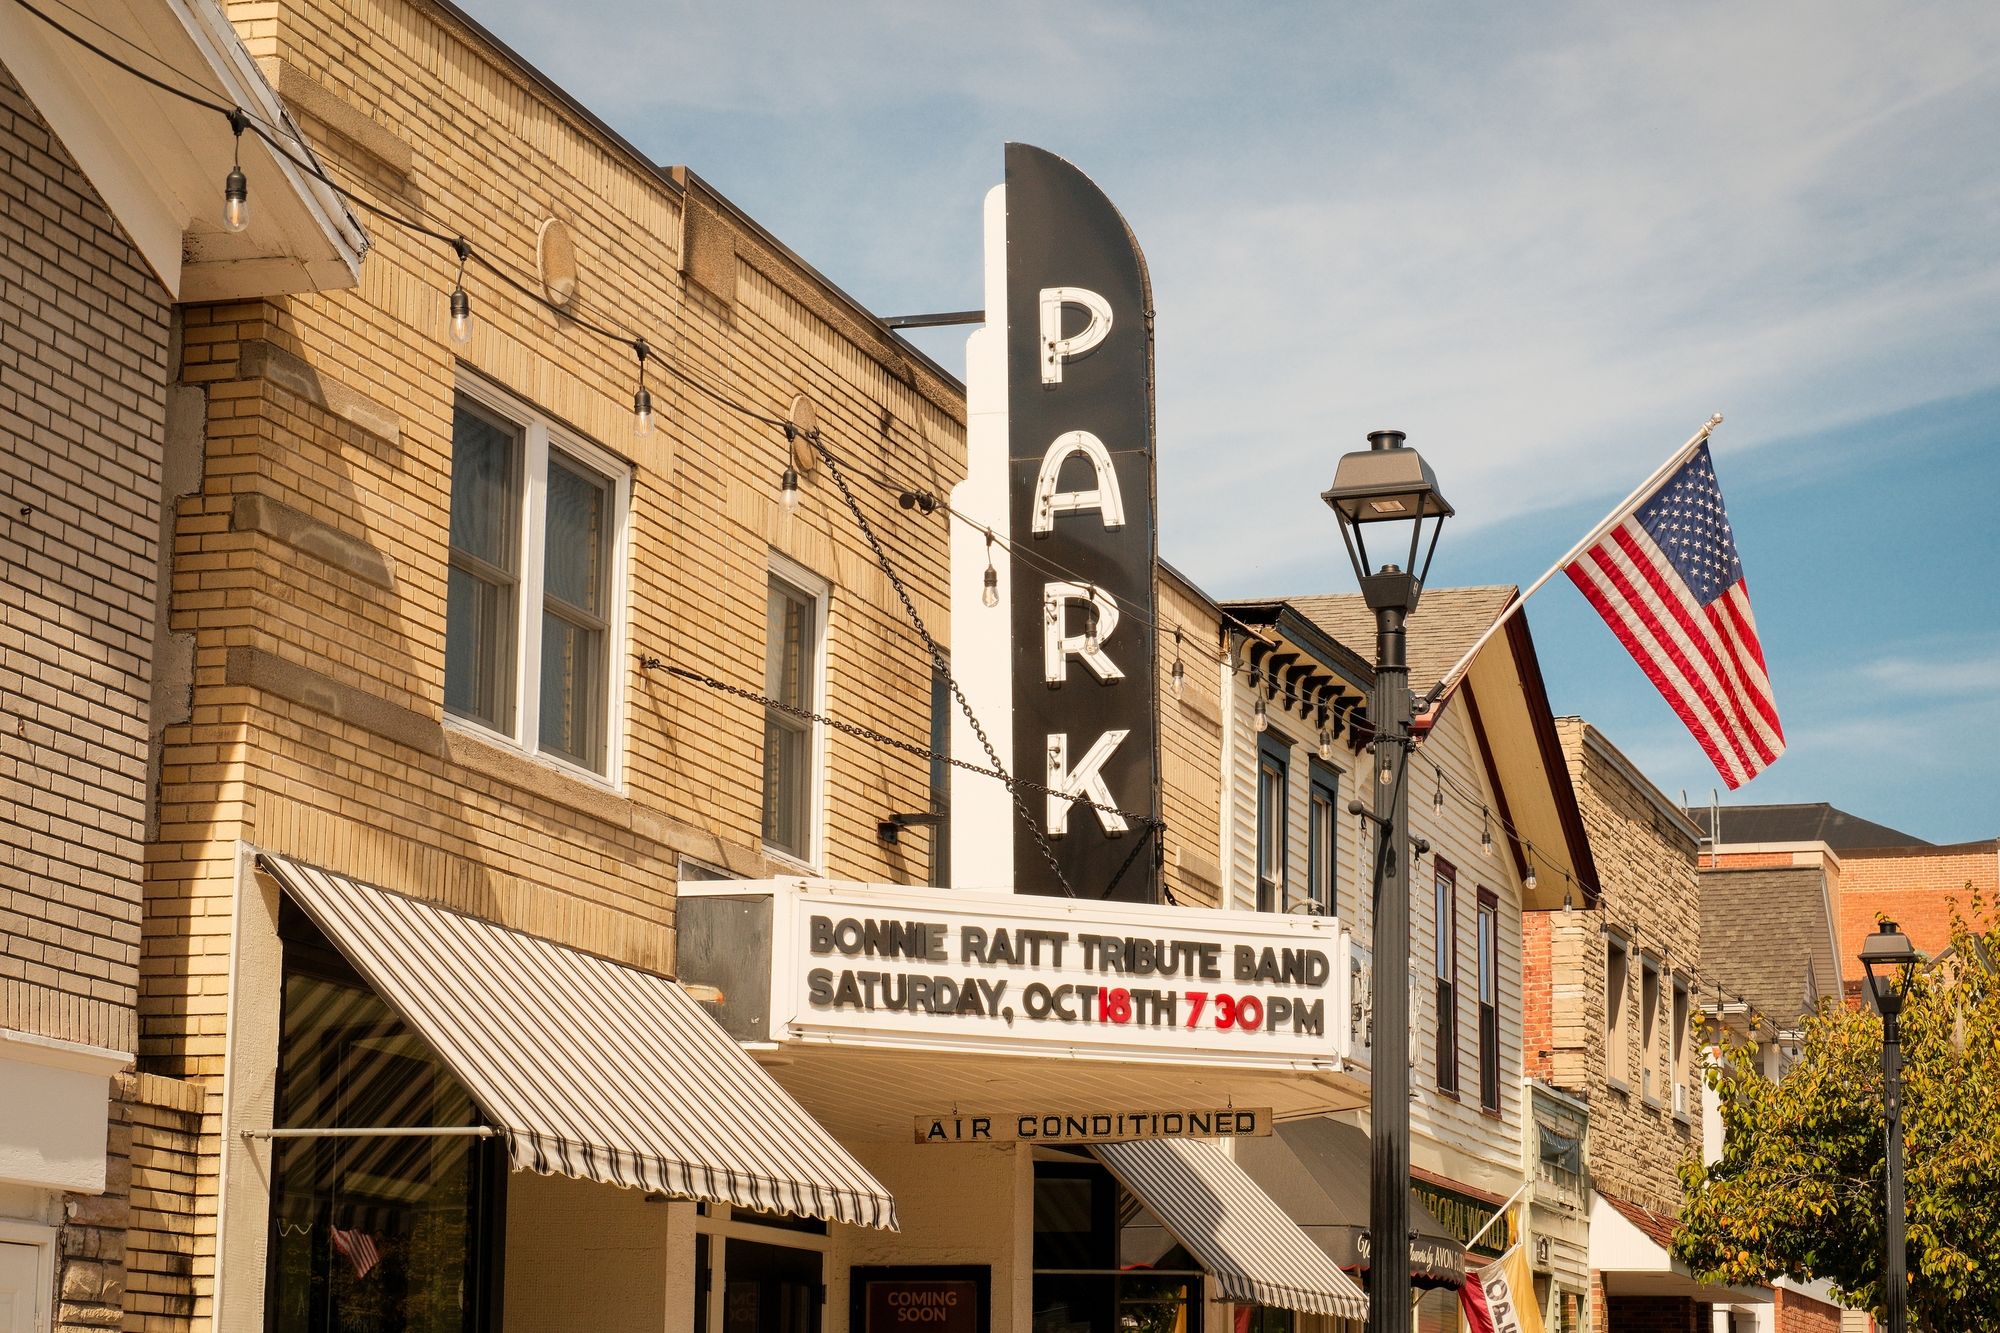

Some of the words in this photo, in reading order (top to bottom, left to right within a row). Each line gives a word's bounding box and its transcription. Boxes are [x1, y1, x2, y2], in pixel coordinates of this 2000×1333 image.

[1031, 286, 1131, 835] PARK
[810, 915, 948, 961] BONNIE
[961, 926, 1069, 968] RAITT
[1078, 933, 1222, 979] TRIBUTE
[1234, 945, 1330, 987] BAND
[807, 968, 1014, 1029] SATURDAY,
[927, 1118, 993, 1141] AIR
[1017, 1111, 1256, 1139] CONDITIONED
[1434, 1246, 1454, 1270] AVON
[888, 1291, 957, 1306] COMING
[898, 1307, 946, 1322] SOON
